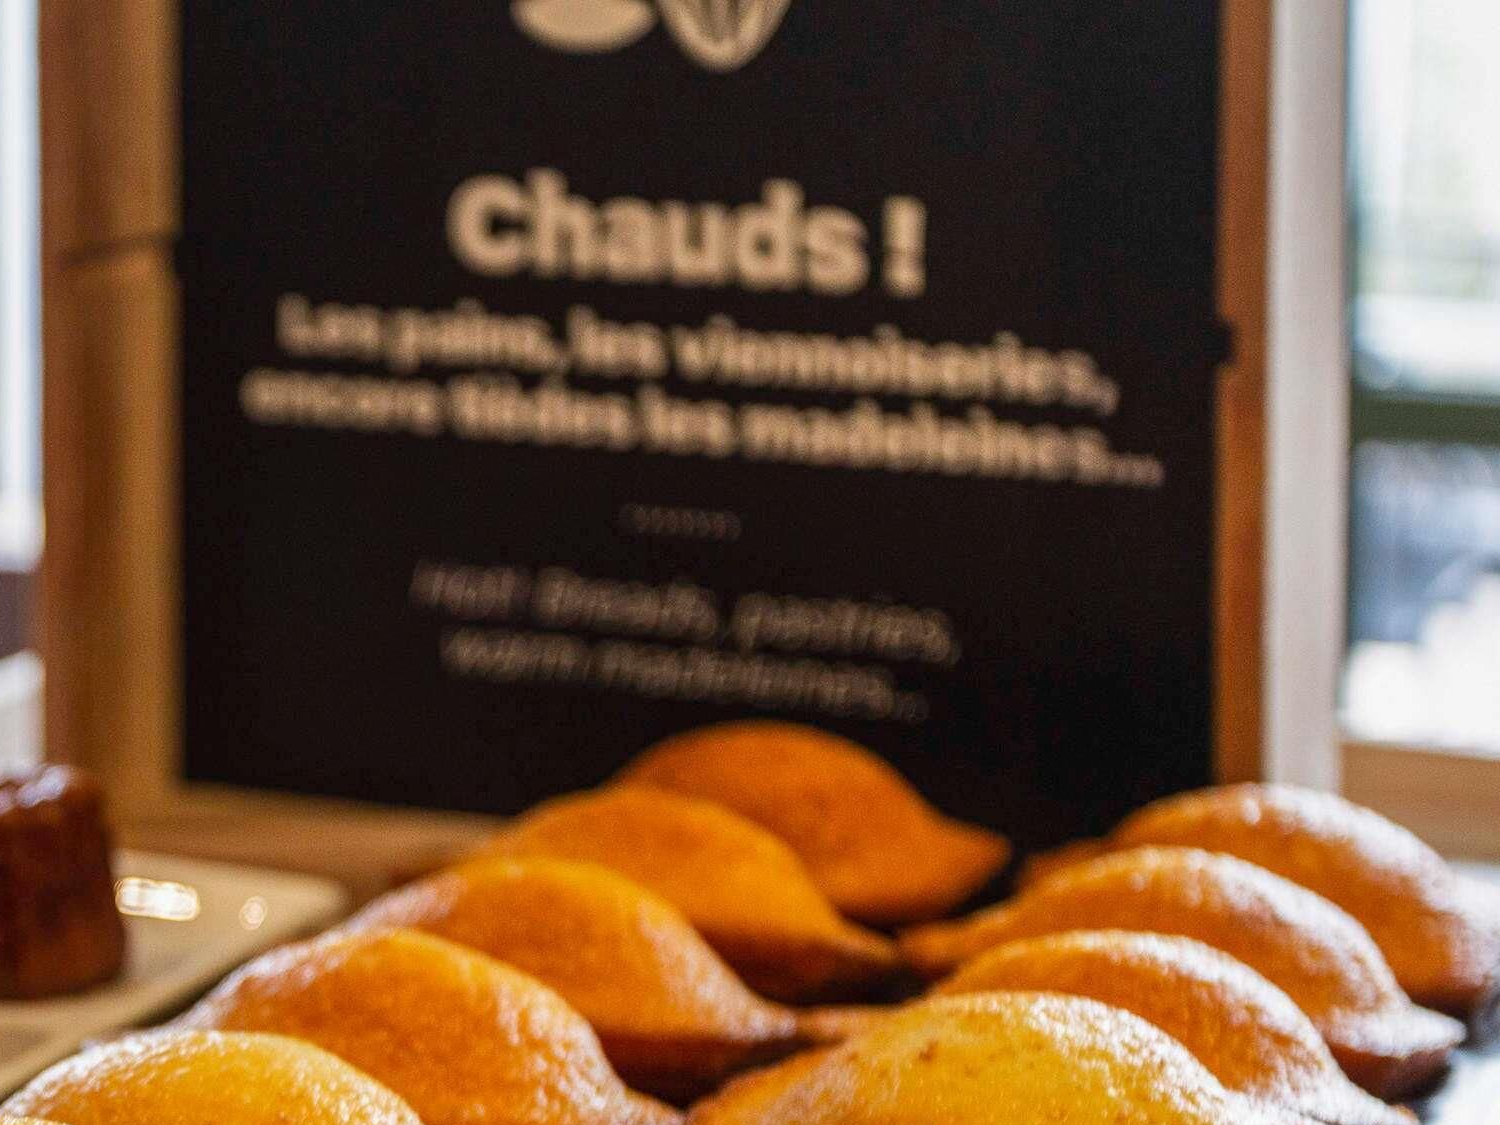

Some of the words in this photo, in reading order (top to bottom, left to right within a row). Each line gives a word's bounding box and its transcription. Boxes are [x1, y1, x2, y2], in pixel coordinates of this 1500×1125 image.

[446, 167, 872, 297] Chauds
[238, 368, 444, 442] encore
[637, 382, 735, 460] les
[275, 293, 383, 360] Les
[386, 298, 566, 376] pains,
[566, 304, 668, 378] les
[670, 314, 1120, 416] viennoiseries,
